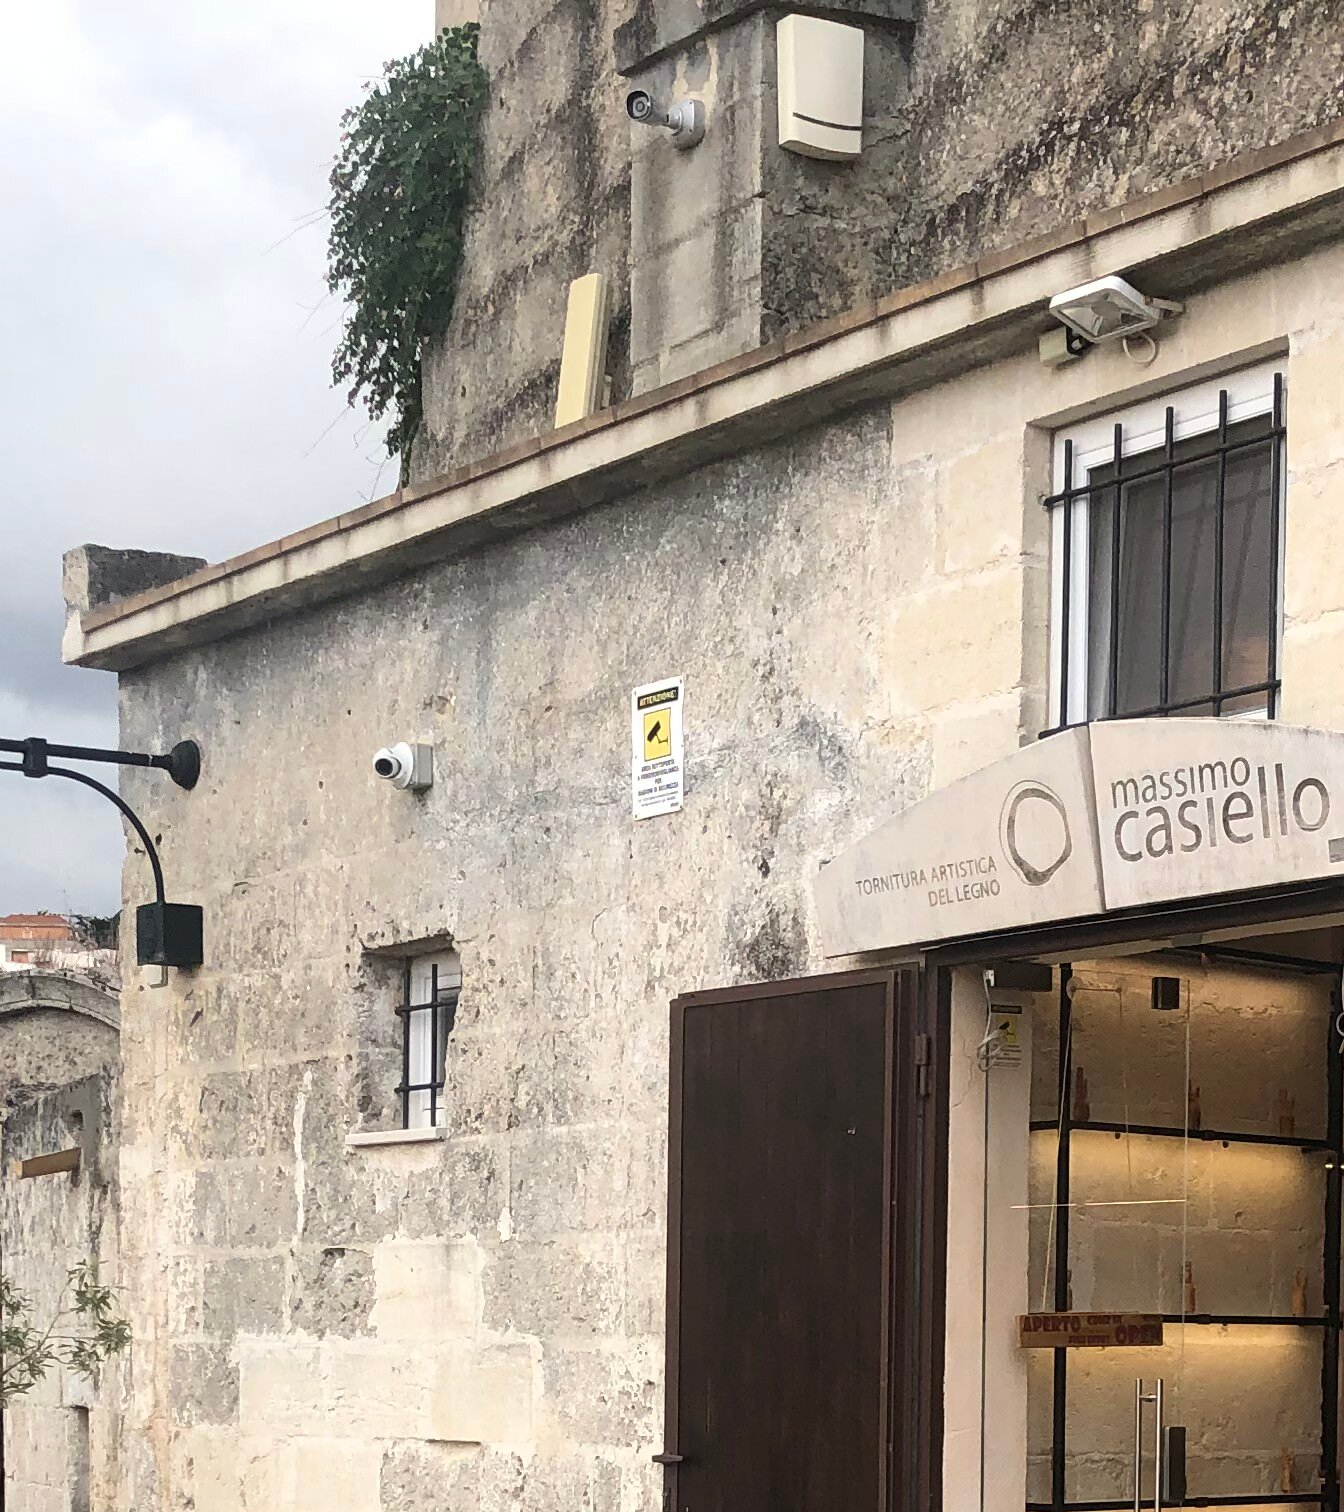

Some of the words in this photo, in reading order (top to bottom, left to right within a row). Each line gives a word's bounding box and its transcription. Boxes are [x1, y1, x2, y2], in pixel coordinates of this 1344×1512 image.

[1110, 757, 1251, 808] massimo
[1114, 763, 1331, 862] casiello
[856, 869, 928, 896] TORNITURA
[931, 855, 998, 883] ARTISTICA
[928, 887, 954, 907] DEL
[956, 878, 1001, 902] LEGNO
